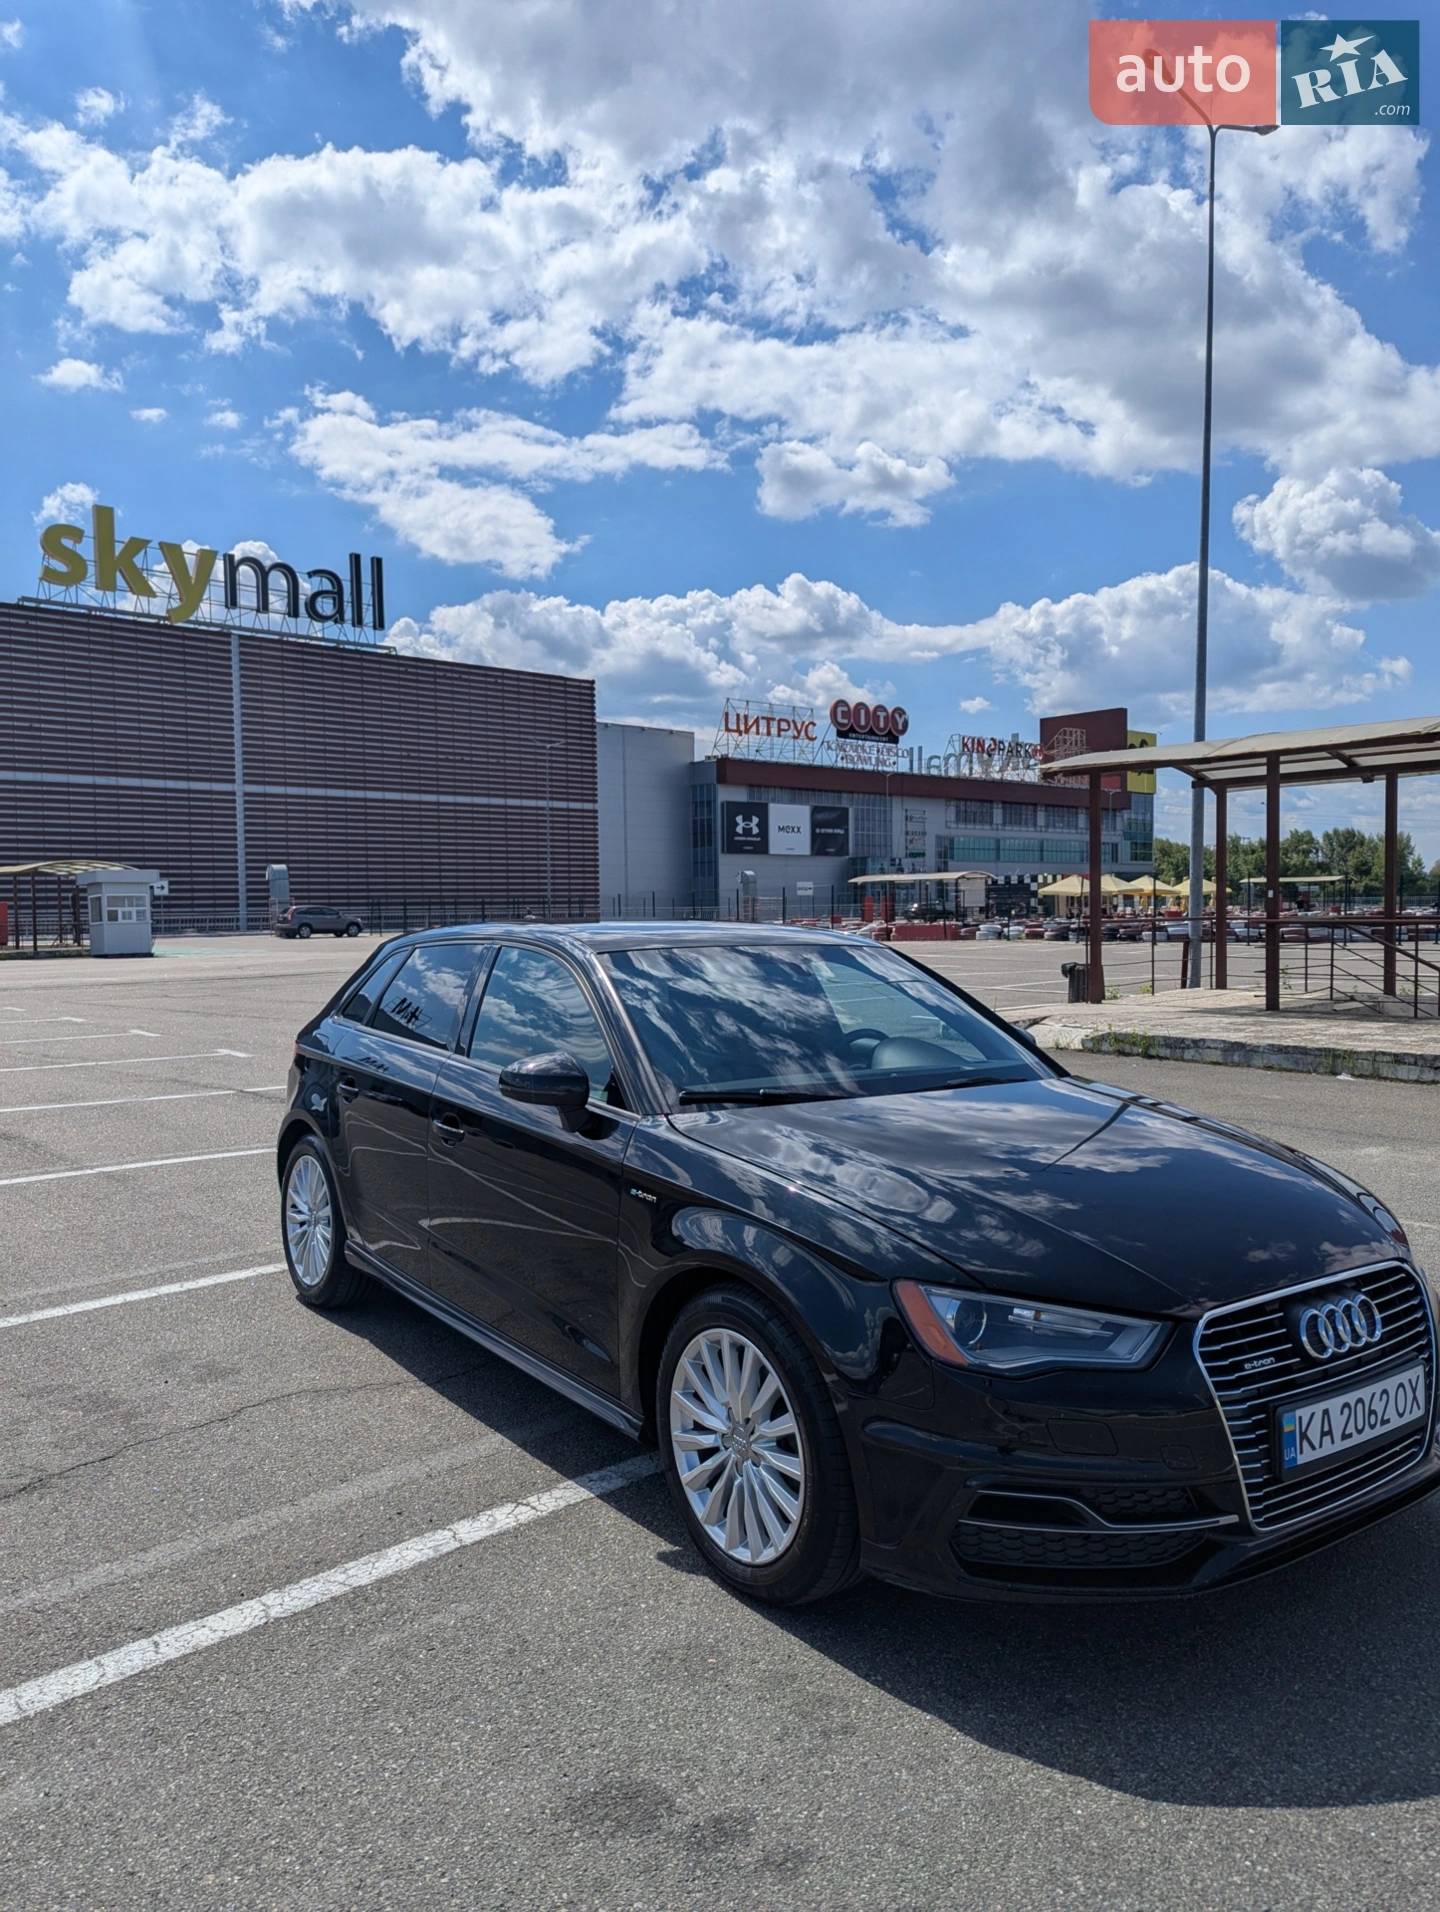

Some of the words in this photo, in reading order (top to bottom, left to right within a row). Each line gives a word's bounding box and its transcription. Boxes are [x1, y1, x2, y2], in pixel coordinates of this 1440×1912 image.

[40, 504, 385, 631] skymall
[724, 711, 818, 742] ЦИТРУС
[835, 705, 907, 732] CITY
[826, 740, 875, 756] KARAOKE
[880, 746, 909, 759] DISCO
[845, 754, 892, 768] BOWLING
[630, 1188, 657, 1203] e-tron
[1244, 1357, 1275, 1369] e-tron
[1299, 1407, 1335, 1455] KA
[1340, 1388, 1391, 1442] 2062
[1394, 1374, 1421, 1418] OX
[1283, 1446, 1297, 1460] UA
